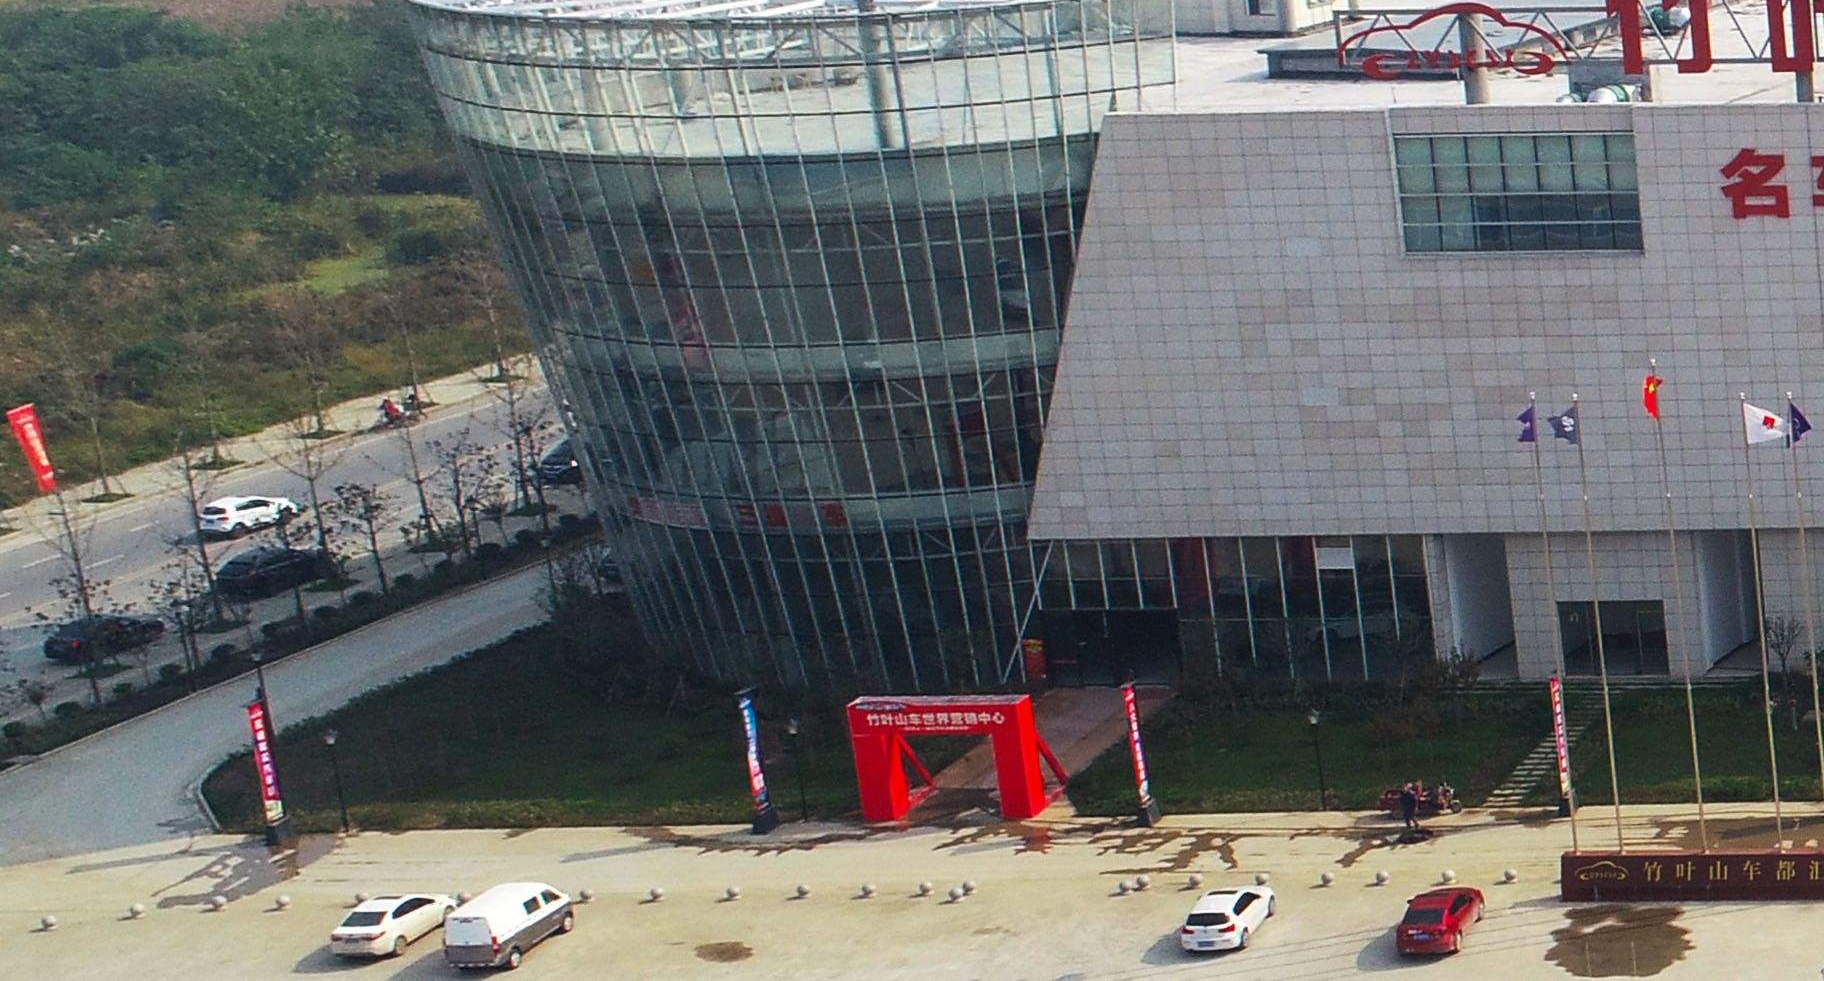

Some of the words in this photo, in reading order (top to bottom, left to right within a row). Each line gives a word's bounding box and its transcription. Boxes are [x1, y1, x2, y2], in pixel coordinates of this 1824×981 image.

[866, 711, 1005, 727] 竹叶山车世界营销中心
